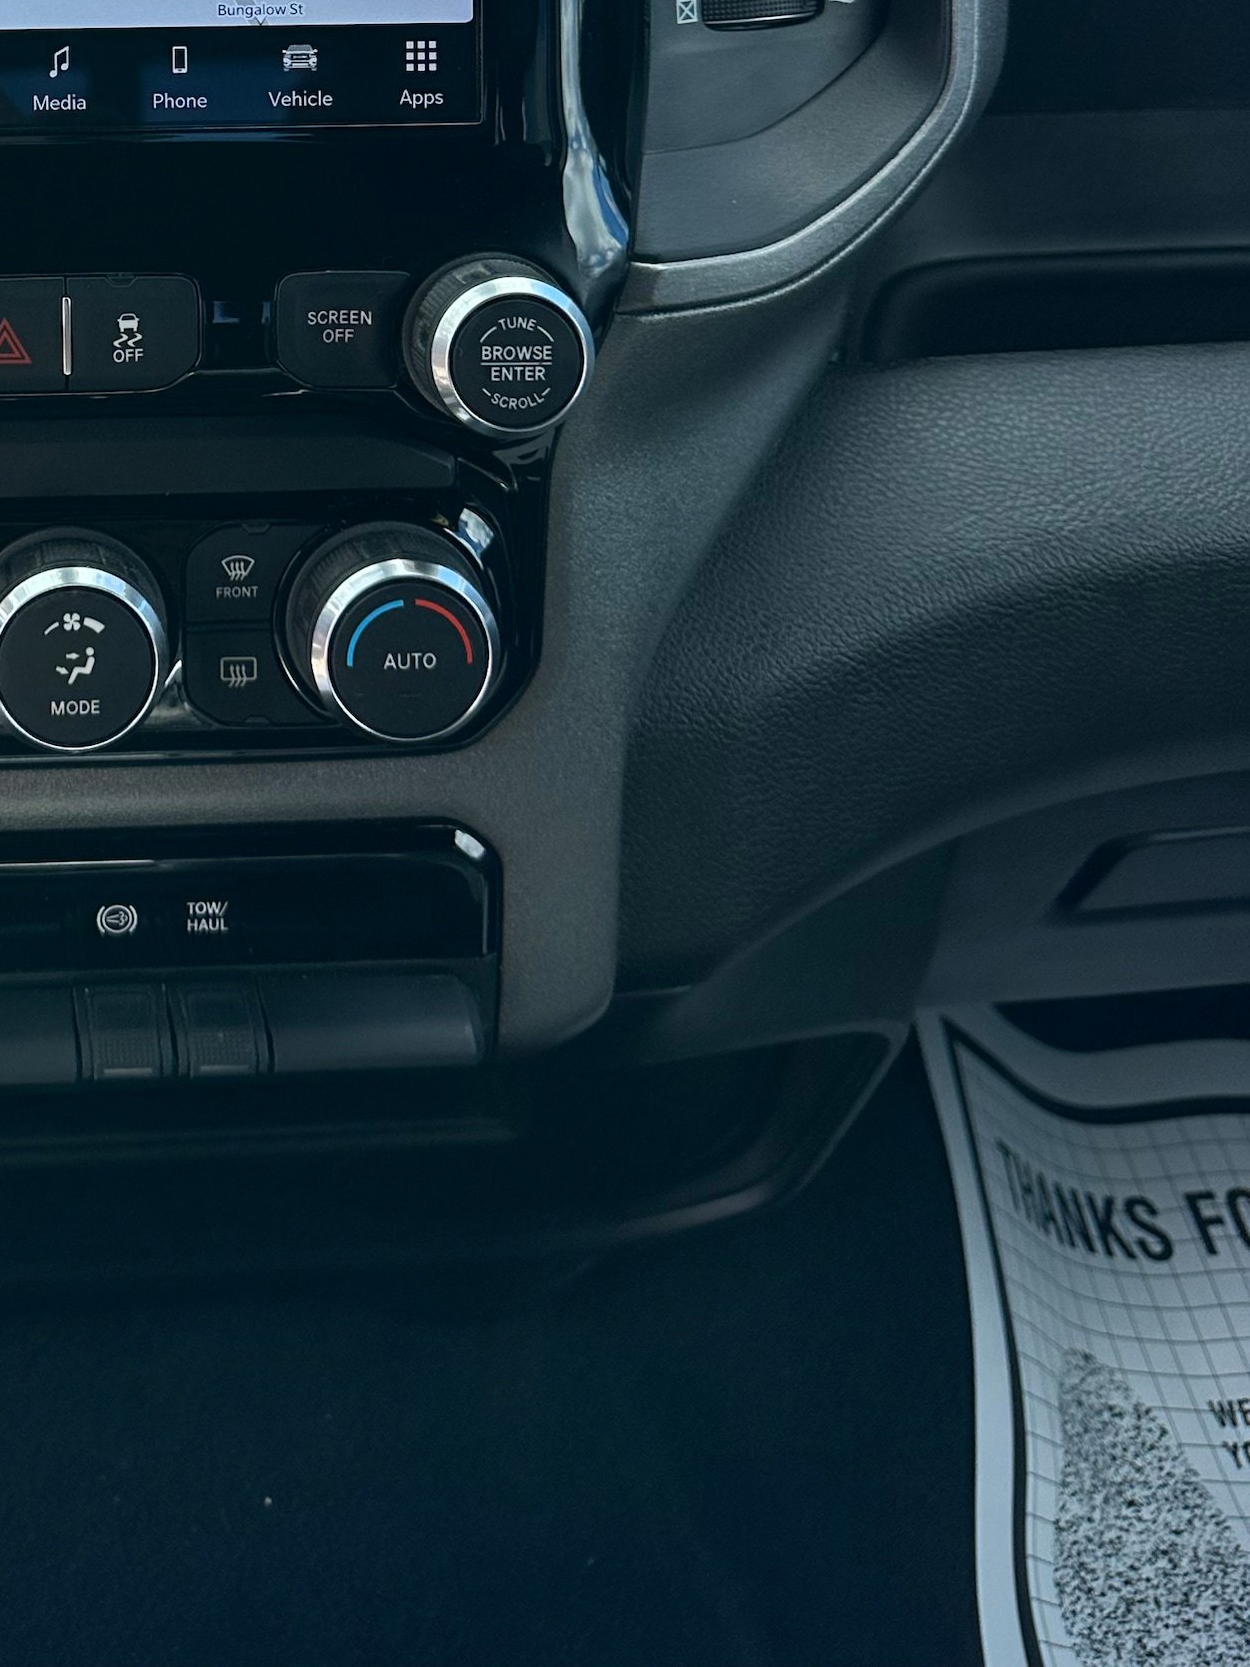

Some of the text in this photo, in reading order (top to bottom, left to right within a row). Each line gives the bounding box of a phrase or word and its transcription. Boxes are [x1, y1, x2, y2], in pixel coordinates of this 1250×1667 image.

[218, 3, 303, 18] Bungalow St
[33, 94, 86, 111] Media
[153, 93, 207, 109] Phone
[268, 91, 333, 108] Vehicle
[400, 90, 444, 109] Apps
[307, 310, 372, 325] SCREEN
[499, 316, 537, 331] TUNE
[323, 329, 354, 343] OFF
[113, 348, 144, 363] OFF
[482, 345, 552, 361] BROWSE
[491, 366, 545, 381] ENTER
[491, 392, 544, 410] SCROLL
[216, 586, 258, 599] FRONT
[384, 652, 437, 669] AUTO
[51, 700, 100, 715] MODE
[187, 901, 228, 916] TOW/
[187, 919, 228, 932] HAUL
[996, 1138, 1174, 1261] THANKS
